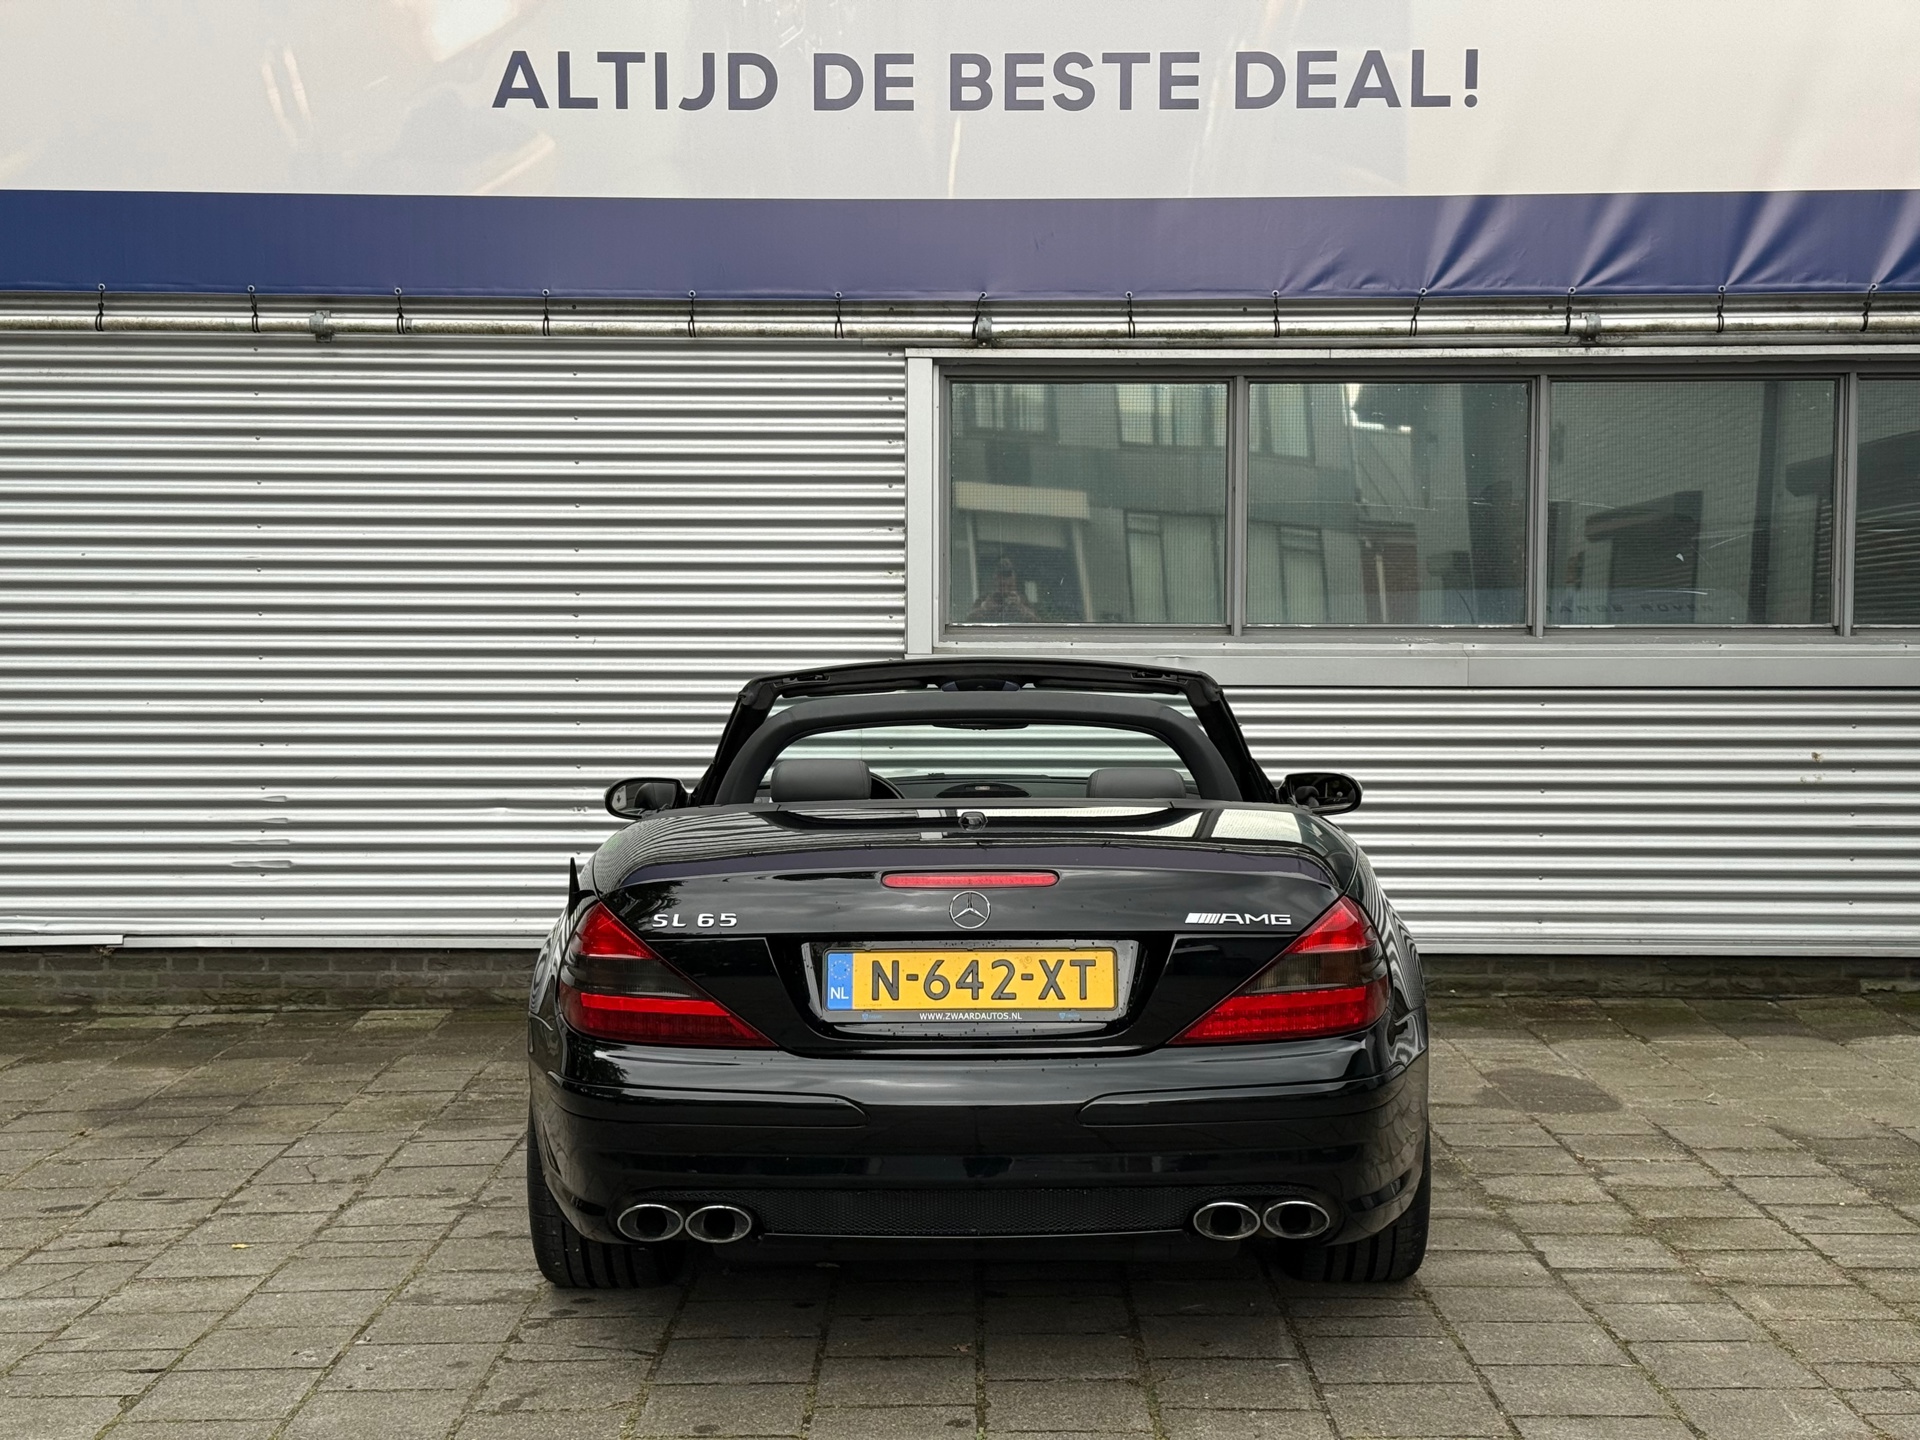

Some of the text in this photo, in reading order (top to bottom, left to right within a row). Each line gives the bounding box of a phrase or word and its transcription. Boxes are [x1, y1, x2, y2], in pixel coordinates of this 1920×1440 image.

[492, 48, 1479, 112] ALTIJD DE BESTE DEAL!
[652, 912, 738, 928] SL 65
[1218, 913, 1292, 925] AMG
[871, 959, 1097, 1001] N-642-XT
[830, 988, 849, 1000] NL
[919, 1012, 1023, 1021] WWW.ZWAARDAUTOS.NL
